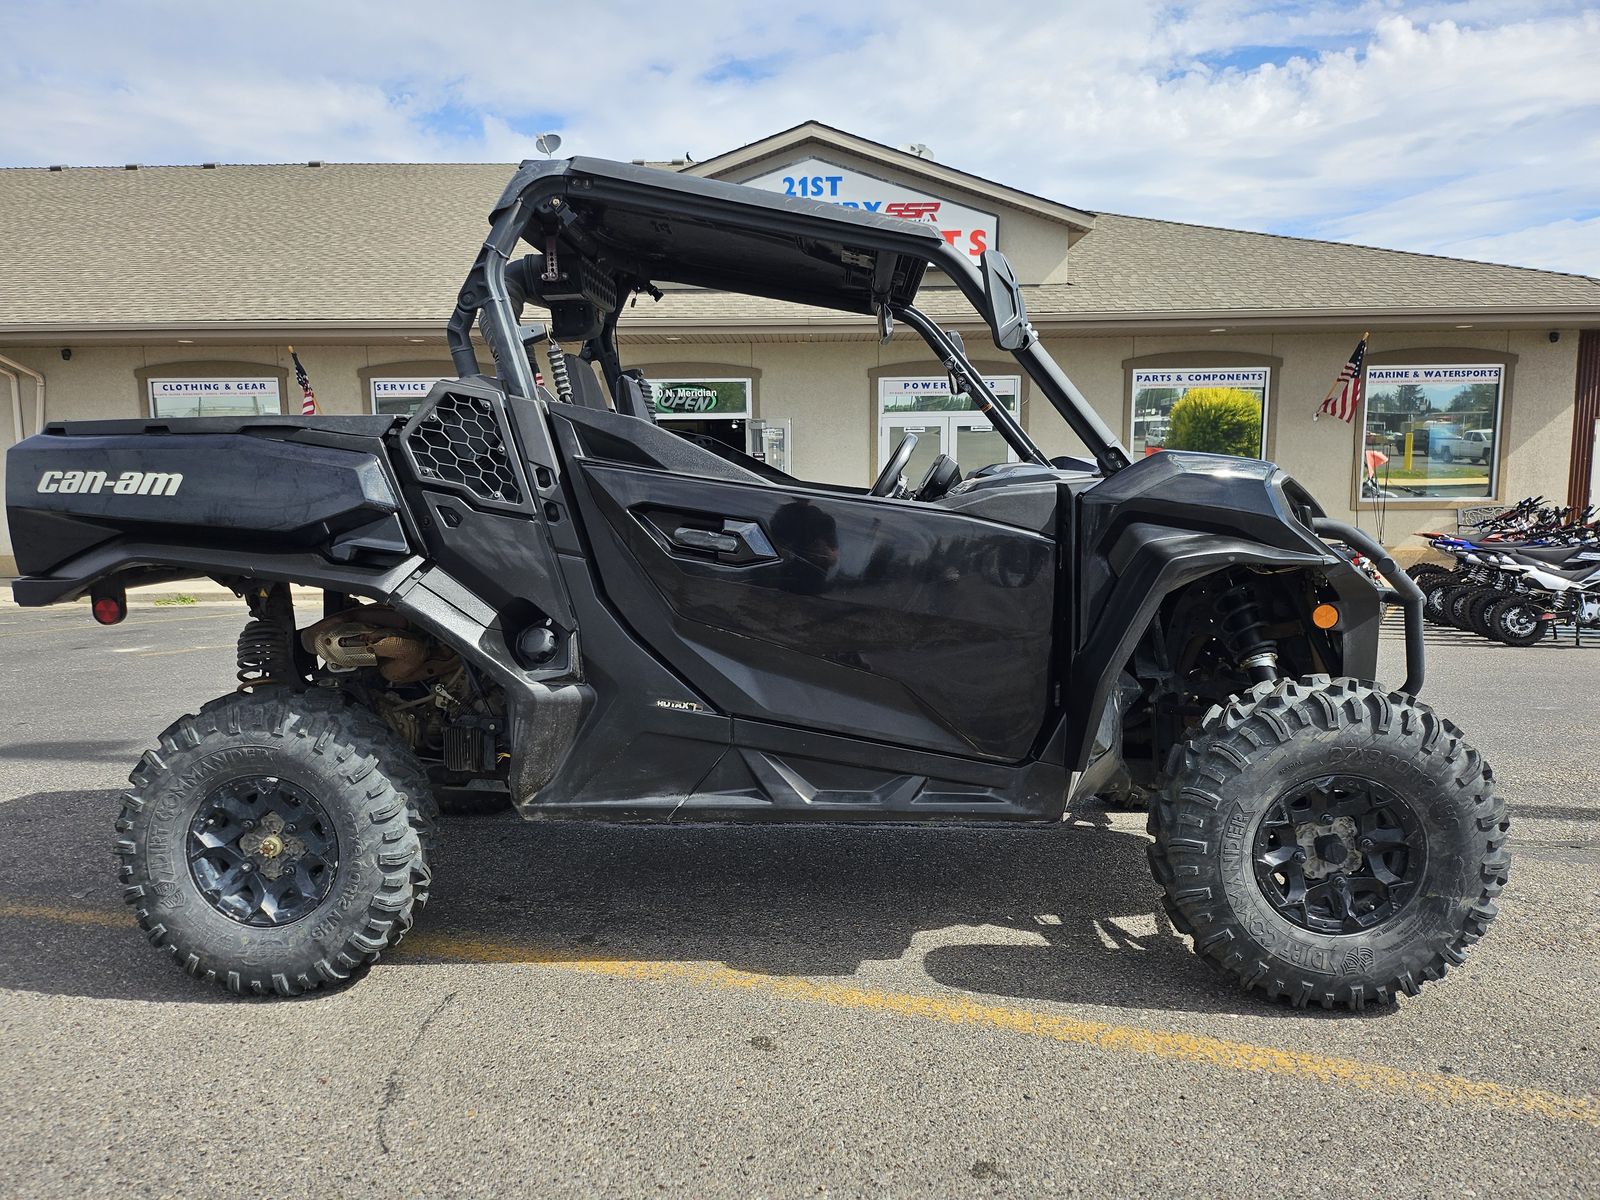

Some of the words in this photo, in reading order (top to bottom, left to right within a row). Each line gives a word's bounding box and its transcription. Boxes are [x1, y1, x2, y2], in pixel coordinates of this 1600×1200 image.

[783, 176, 843, 197] 21ST
[885, 202, 941, 222] SSR
[1136, 374, 1172, 382] PARTS
[1176, 374, 1183, 382] &
[1188, 373, 1263, 382] COMPONENTS
[1368, 371, 1410, 379] MARINE
[1412, 370, 1420, 378] &
[1424, 369, 1500, 378] WATERSPORTS
[162, 383, 220, 391] CLOTHING
[224, 383, 232, 391] &
[237, 383, 267, 391] GEAR
[376, 383, 426, 391] SERVICE
[665, 389, 676, 397] N.
[677, 388, 717, 397] Meridian
[660, 391, 711, 412] OPEN
[37, 471, 184, 496] can-am
